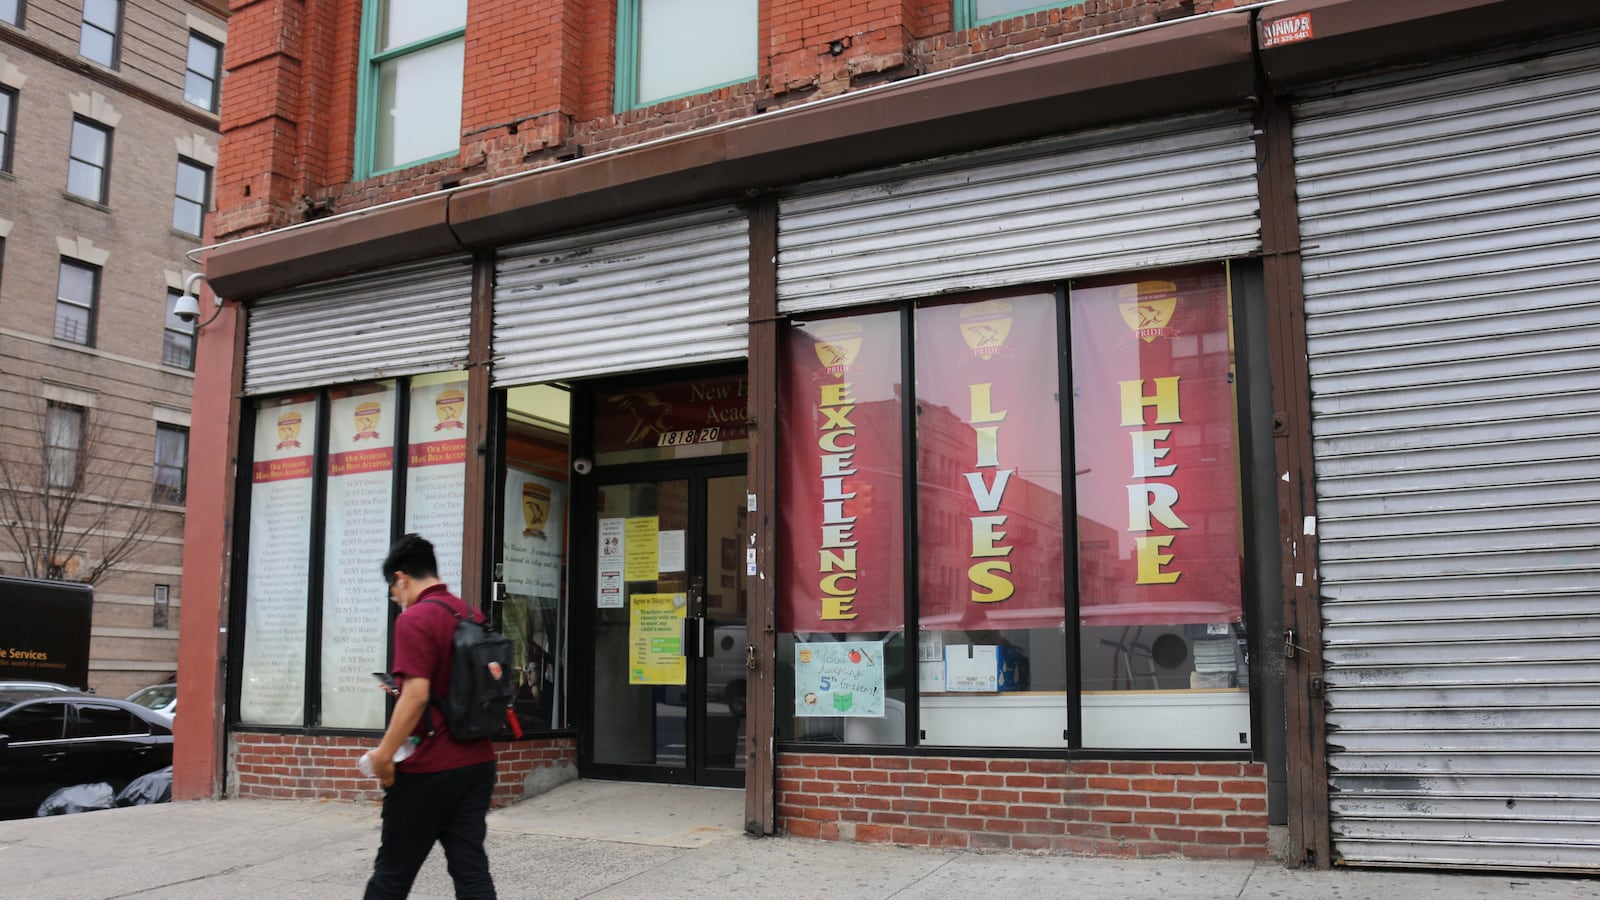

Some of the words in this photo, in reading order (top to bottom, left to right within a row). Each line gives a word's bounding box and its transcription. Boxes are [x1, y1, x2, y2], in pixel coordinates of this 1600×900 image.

[1135, 328, 1164, 338] PRIDE
[690, 384, 729, 402] New
[662, 431, 694, 445] 1818
[701, 428, 718, 441] 20
[1118, 375, 1189, 585] HERE
[818, 383, 859, 621] EXCELLENCE
[963, 383, 1015, 603] LIVES
[9, 648, 47, 660] Services
